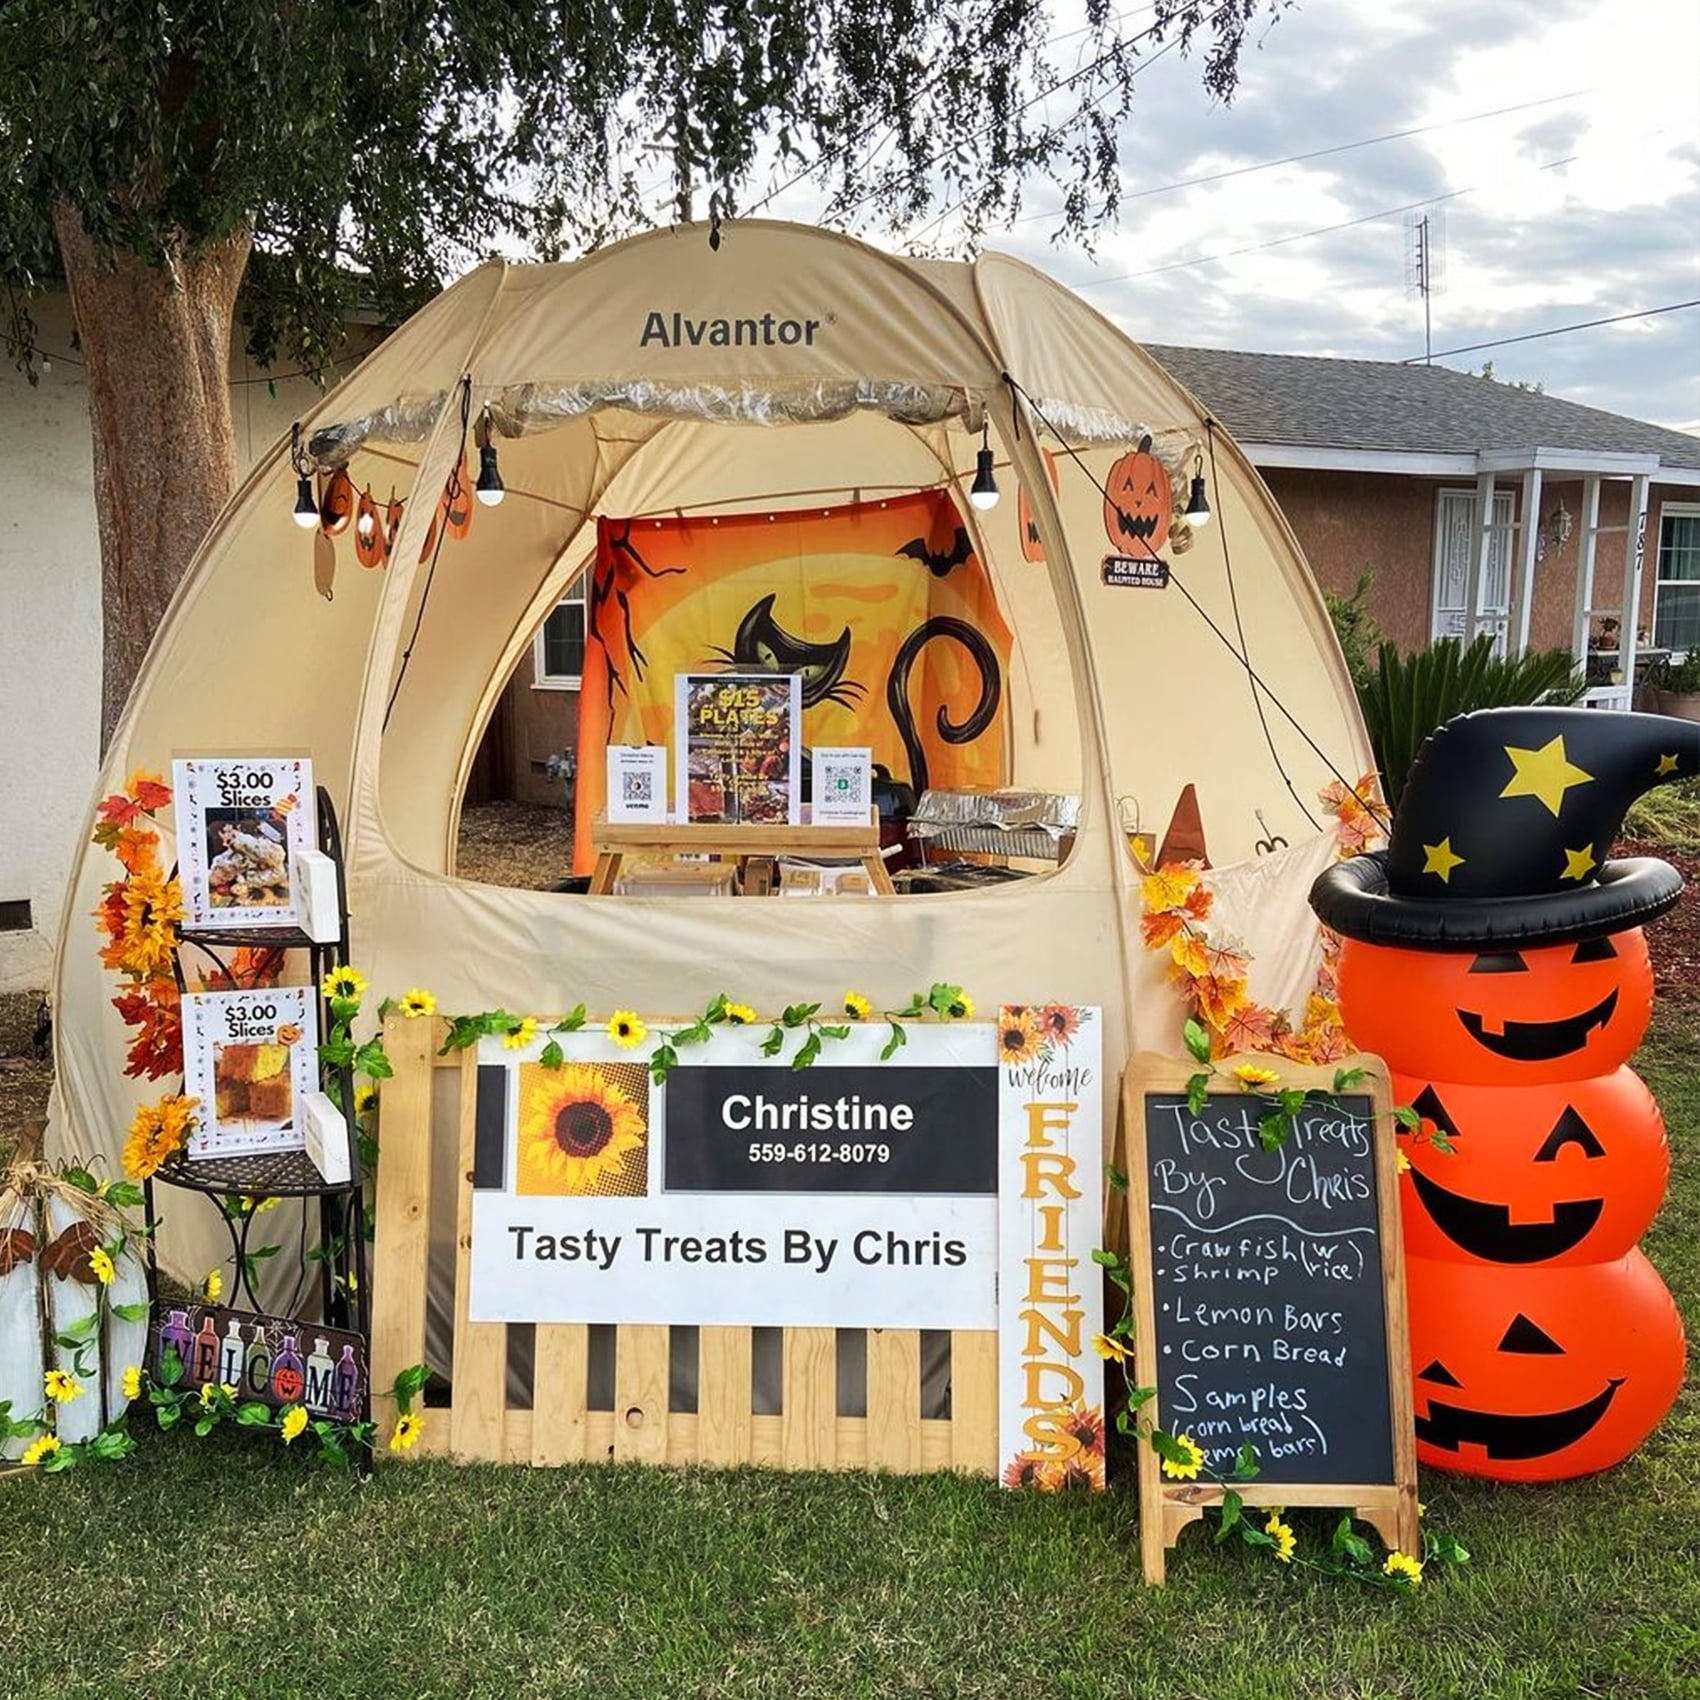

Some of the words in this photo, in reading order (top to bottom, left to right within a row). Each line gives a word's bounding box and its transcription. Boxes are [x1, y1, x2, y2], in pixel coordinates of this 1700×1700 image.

[1114, 560, 1159, 577] BEWARE
[718, 687, 762, 709] $15
[700, 708, 779, 725] PLATES
[216, 771, 274, 791] $3.00
[220, 790, 271, 808] Slices
[224, 1004, 277, 1024] $3.00
[228, 1022, 275, 1039] Slices
[1008, 1058, 1092, 1096] welcome
[722, 1094, 915, 1132] Christine
[748, 1143, 891, 1164] 559-612-8079
[1154, 1158, 1227, 1219] By
[1286, 1154, 1370, 1209] Chris
[508, 1226, 622, 1270] Tasty
[636, 1227, 768, 1264] Treats
[783, 1230, 839, 1273] By
[853, 1231, 968, 1266] Chris
[1020, 1102, 1084, 1463] FRIENDS
[1176, 1296, 1274, 1326] Lemon
[1284, 1304, 1342, 1334] Bars
[1182, 1339, 1261, 1363] Corn
[1273, 1338, 1347, 1367] Bread
[1172, 1373, 1308, 1415] Samples
[1238, 1411, 1293, 1436] bread
